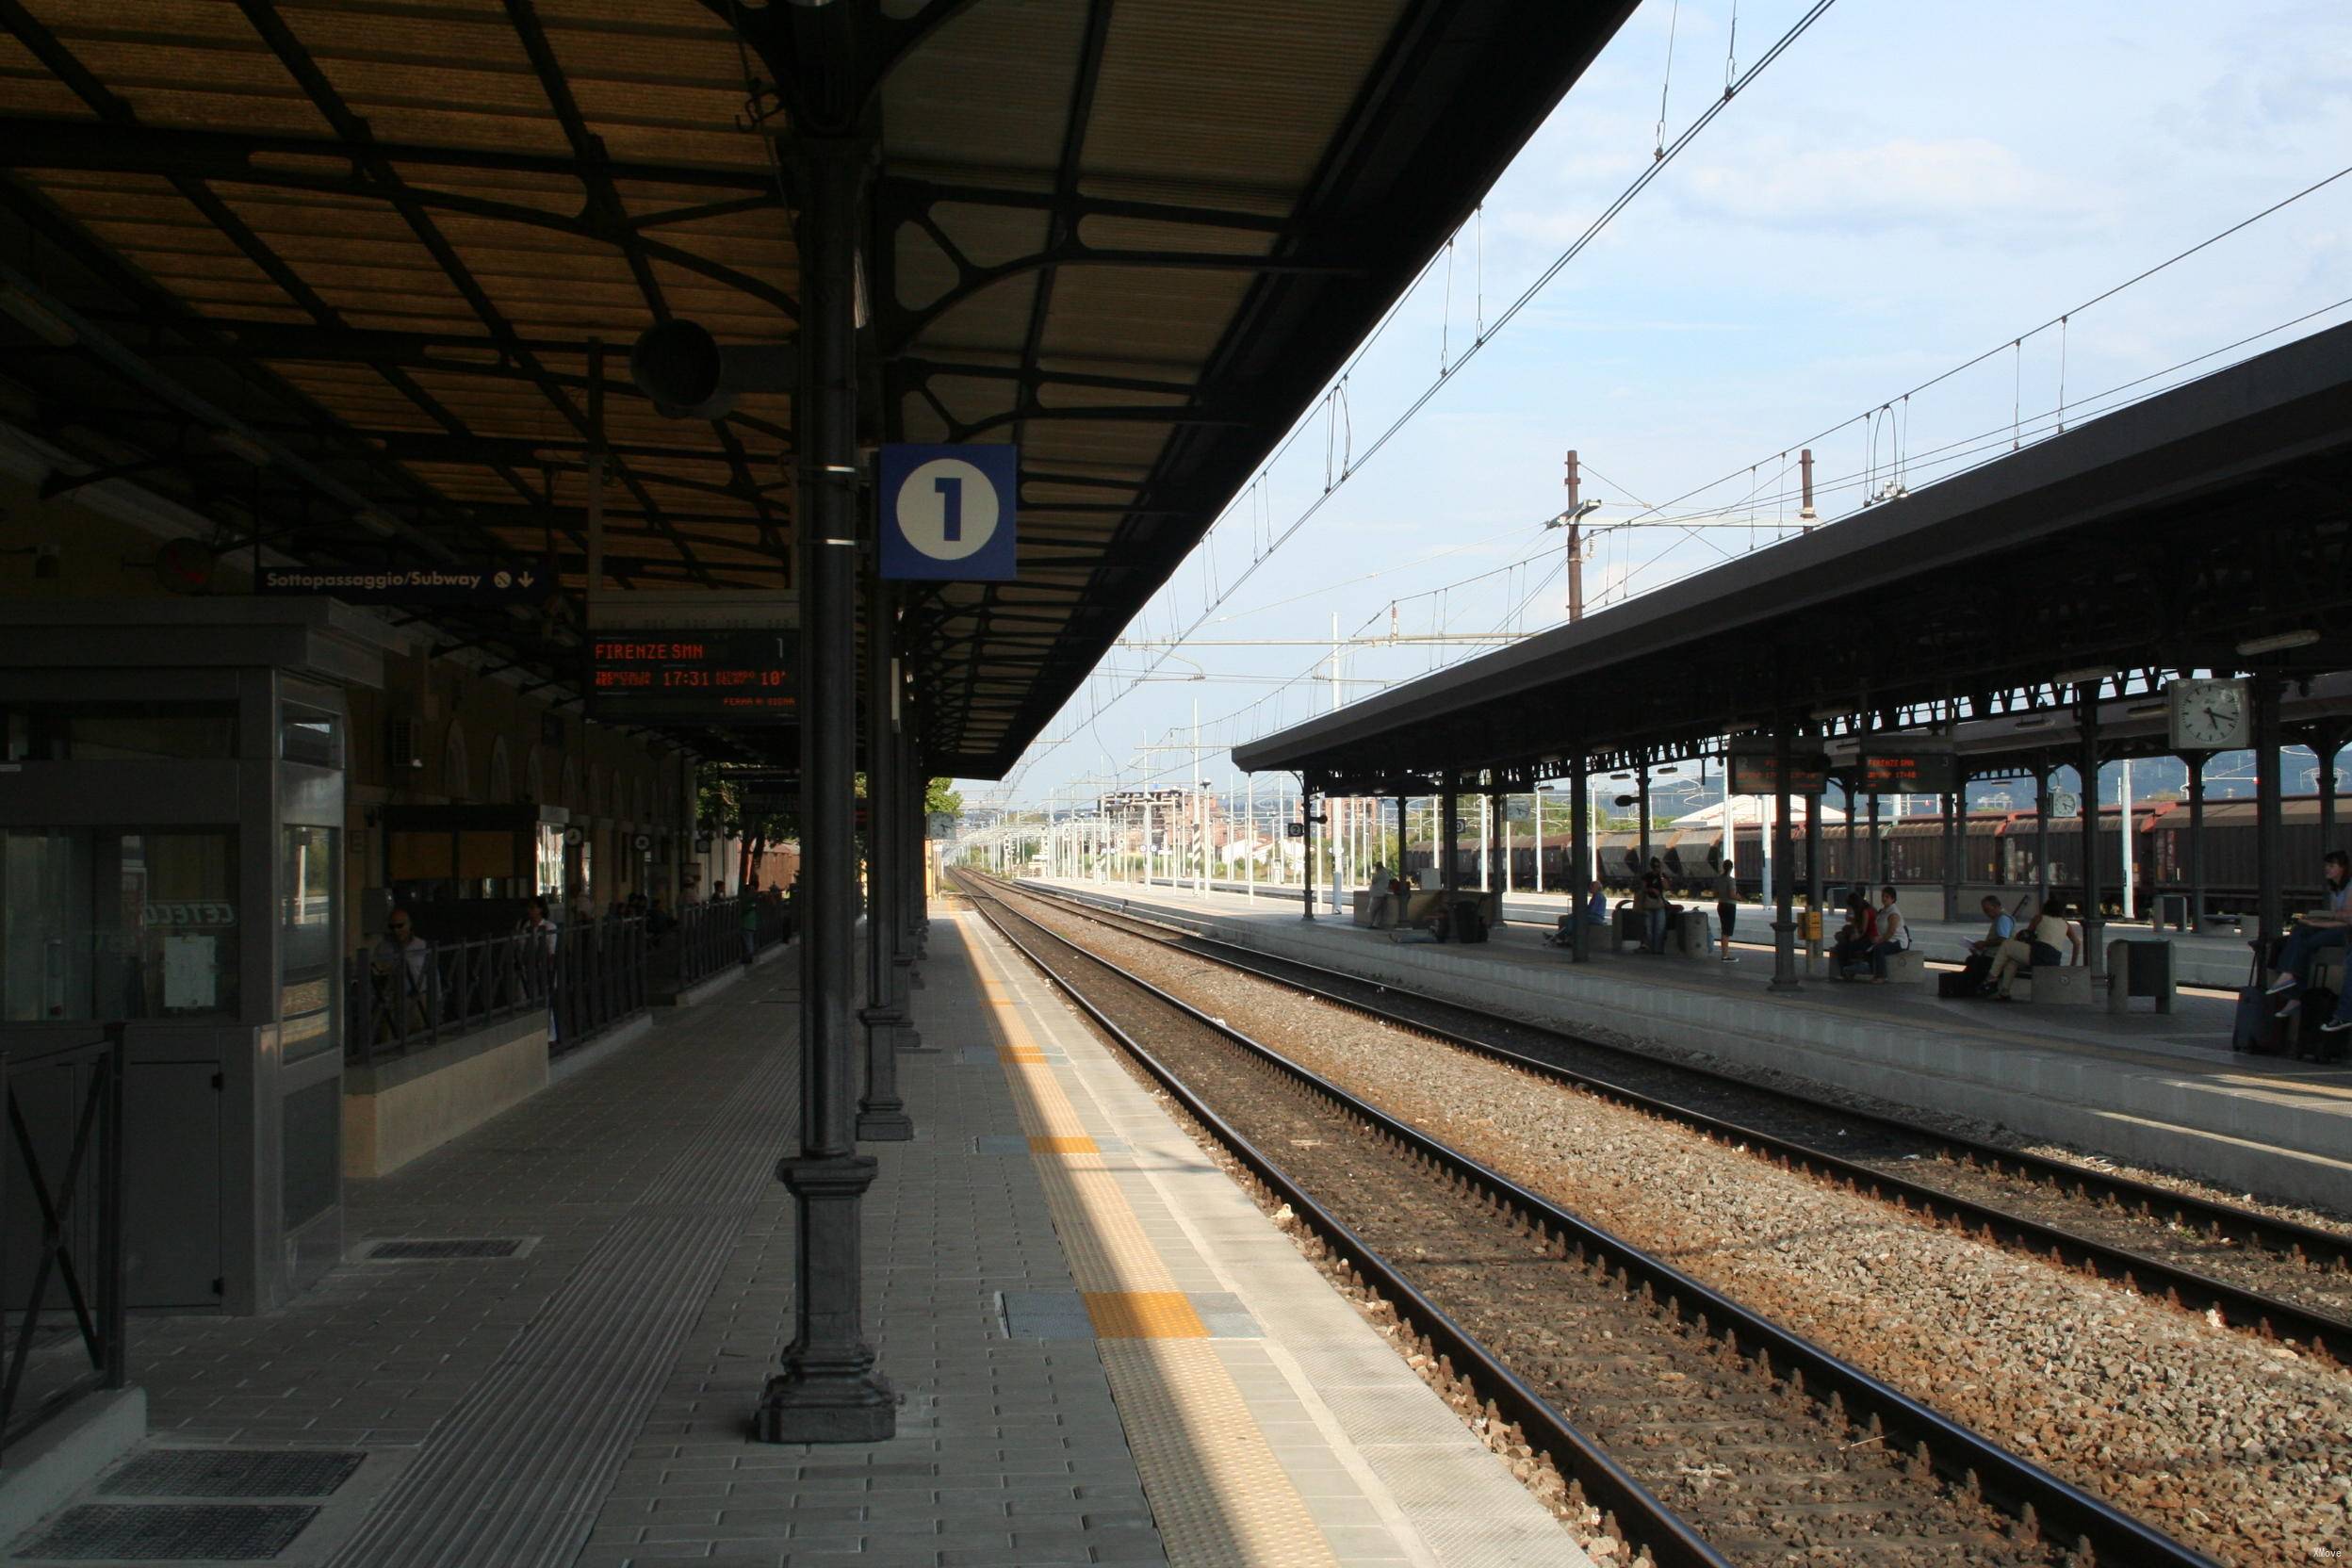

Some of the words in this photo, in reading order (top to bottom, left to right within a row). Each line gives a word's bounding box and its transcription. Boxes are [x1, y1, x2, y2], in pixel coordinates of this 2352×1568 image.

[935, 478, 961, 541] 1
[266, 571, 482, 589] Sottopassaggio/Subway
[595, 644, 667, 660] FIRENZE
[671, 644, 704, 660] SMN
[776, 638, 783, 659] 1
[663, 670, 709, 686] 17:31
